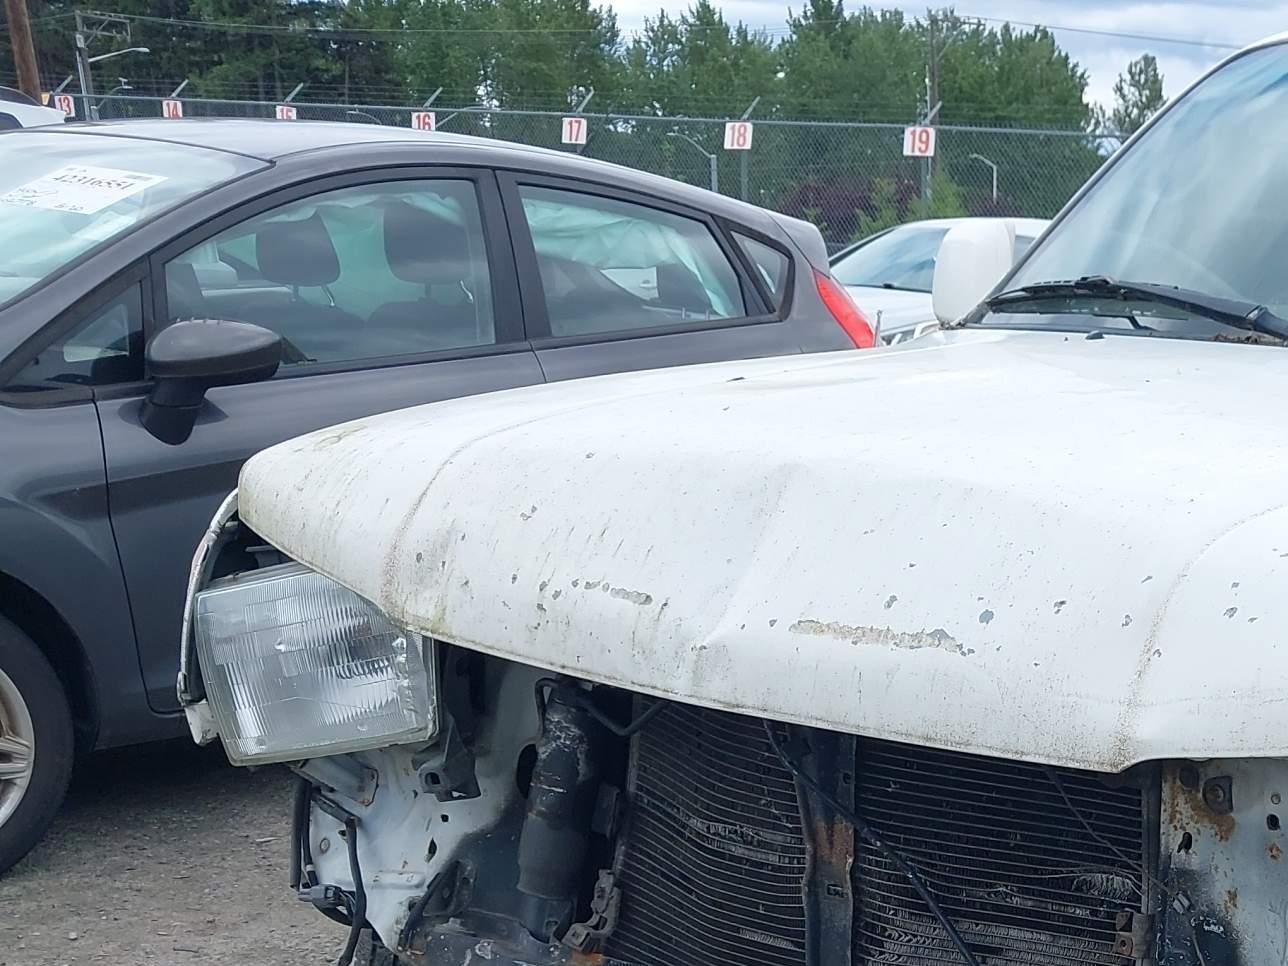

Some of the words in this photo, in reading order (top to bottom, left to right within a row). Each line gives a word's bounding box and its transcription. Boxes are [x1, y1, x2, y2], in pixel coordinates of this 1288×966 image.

[58, 96, 72, 115] 13
[166, 102, 180, 118] 14
[415, 113, 432, 130] 16
[567, 119, 582, 142] 17
[728, 124, 747, 148] 18
[909, 129, 930, 154] 19
